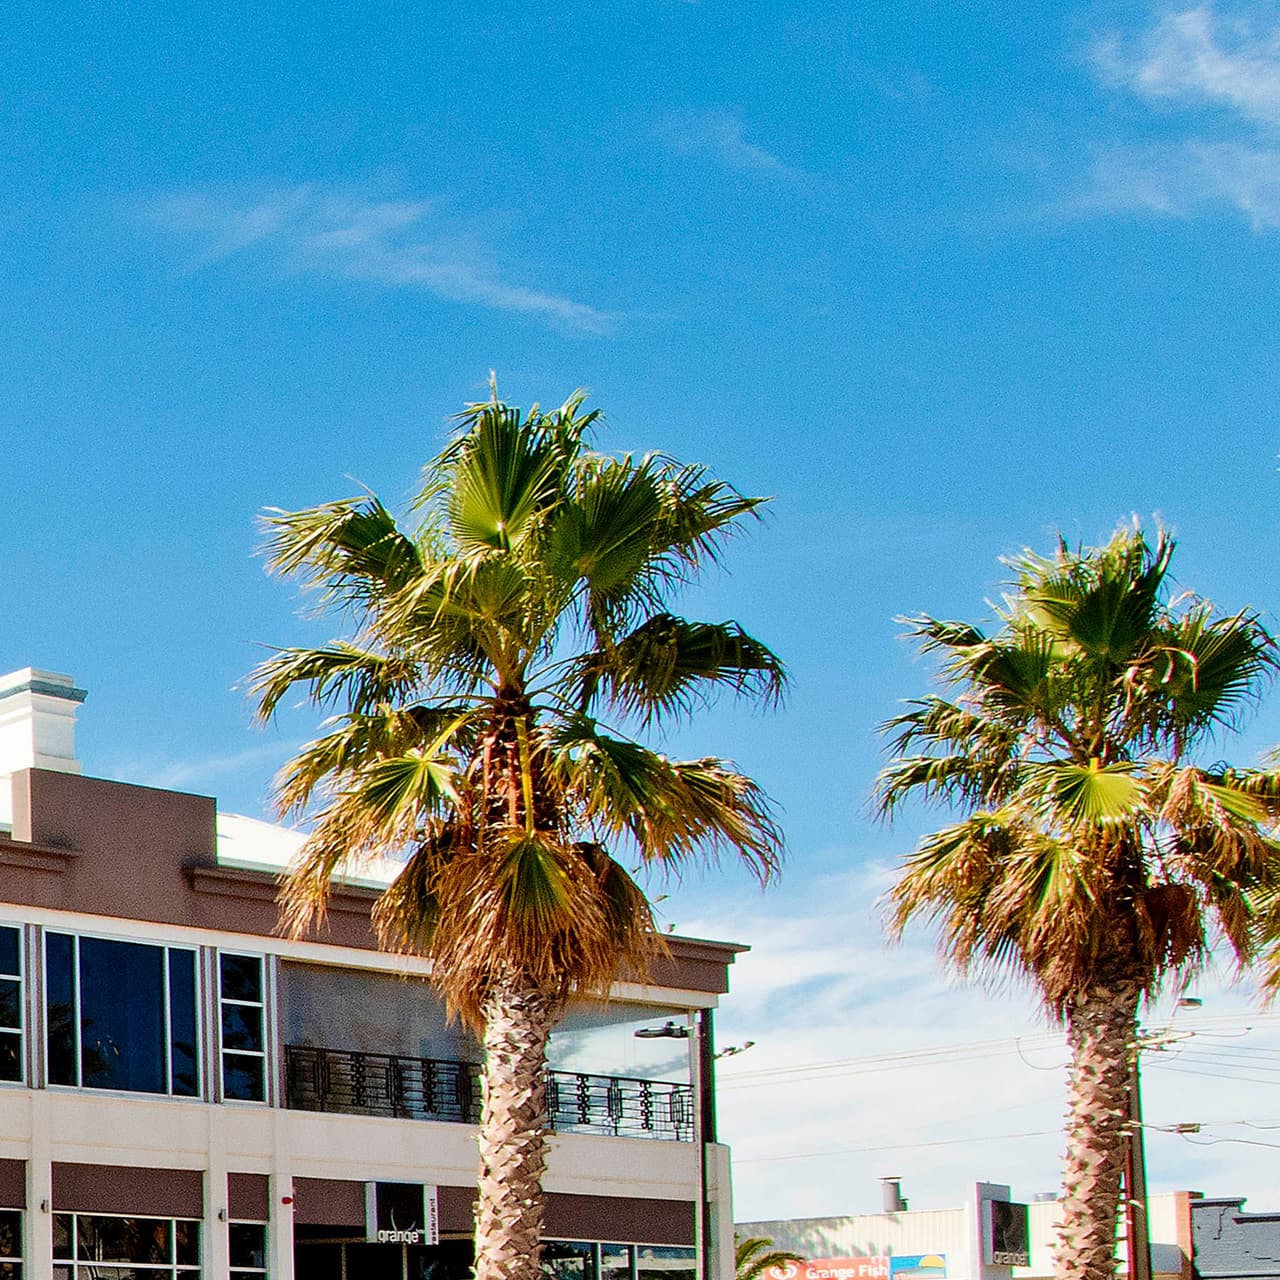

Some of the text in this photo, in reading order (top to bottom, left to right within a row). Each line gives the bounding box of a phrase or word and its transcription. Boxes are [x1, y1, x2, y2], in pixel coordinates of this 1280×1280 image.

[378, 1230, 419, 1244] grange
[805, 1267, 855, 1280] Grange
[858, 1264, 888, 1277] Fish
